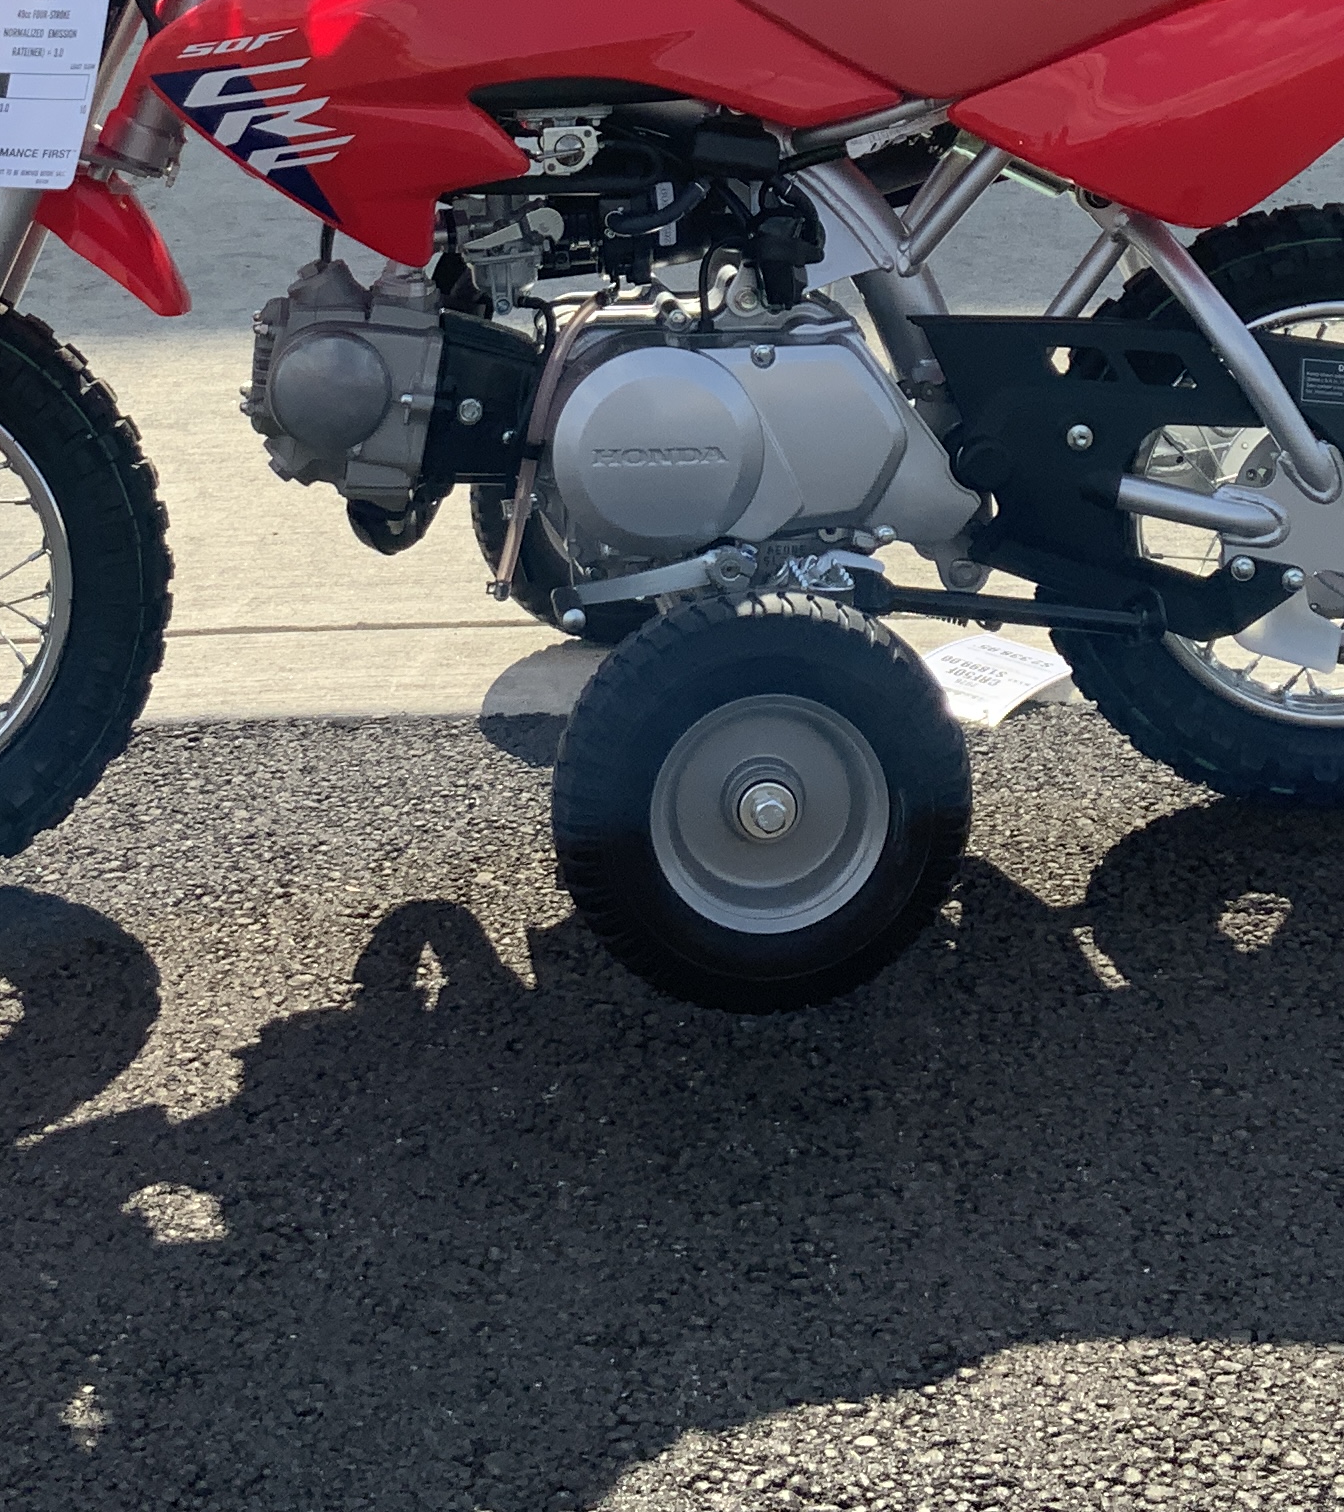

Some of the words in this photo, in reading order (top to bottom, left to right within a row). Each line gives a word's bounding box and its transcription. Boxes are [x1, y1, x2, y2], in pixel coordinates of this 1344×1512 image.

[177, 27, 299, 59] 50F
[183, 57, 356, 178] CRF
[591, 445, 729, 468] HONDA
[946, 667, 1002, 687] CRF50F
